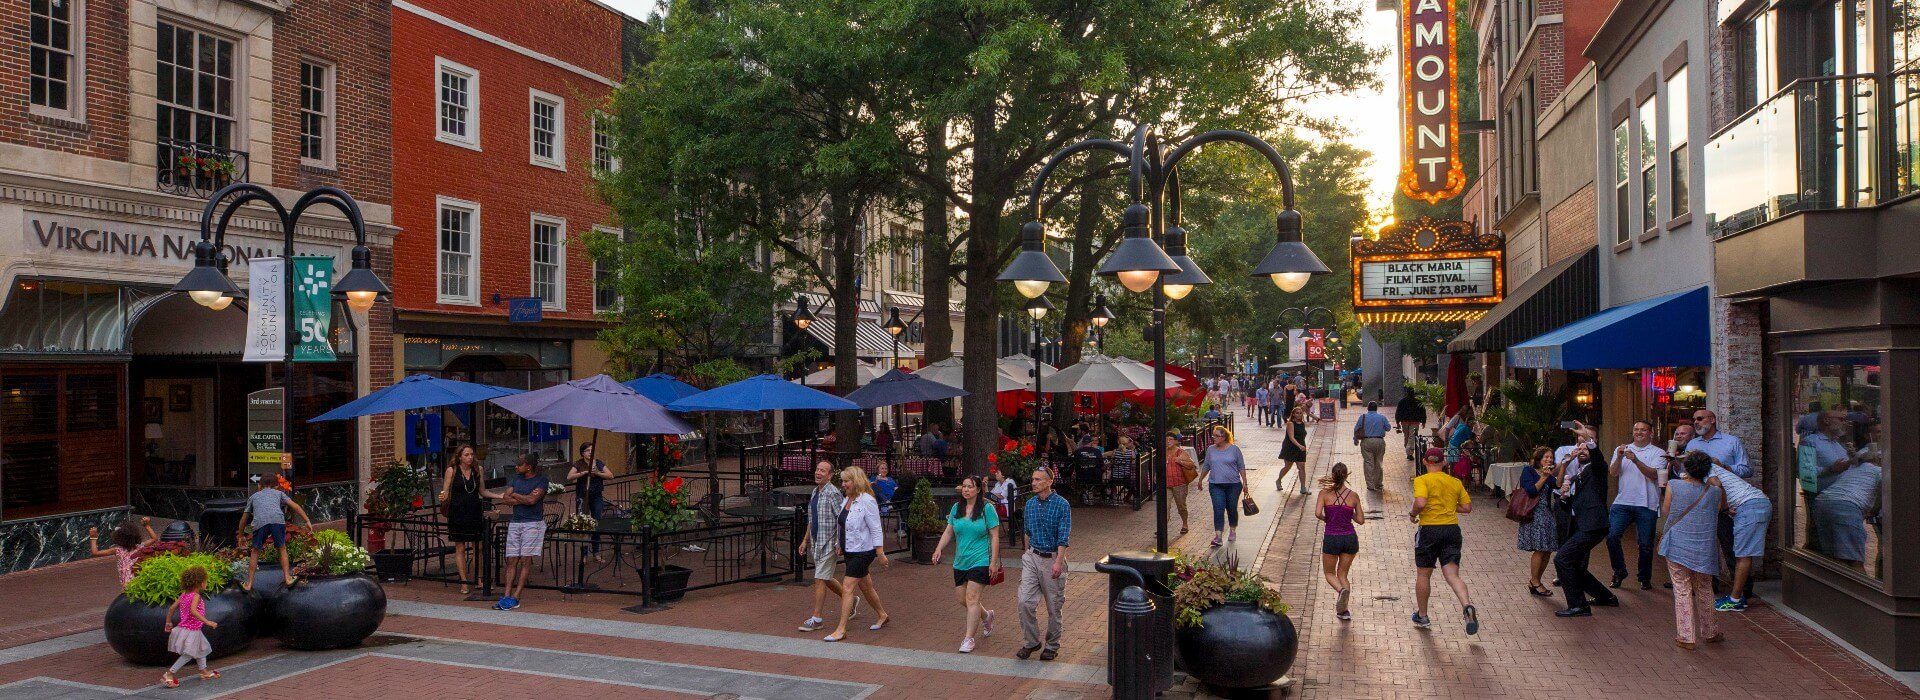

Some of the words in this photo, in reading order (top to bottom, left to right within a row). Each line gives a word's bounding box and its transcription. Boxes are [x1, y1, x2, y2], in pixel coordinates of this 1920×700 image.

[33, 219, 157, 258] VIRGINIA
[163, 234, 274, 267] NAONA
[1388, 264, 1424, 273] BLACK
[1427, 262, 1463, 272] MARIA
[1386, 275, 1411, 285] FILM
[1415, 273, 1465, 284] FESTIVAL
[1383, 287, 1404, 297] FRI.
[1409, 286, 1437, 296] JUNE
[269, 264, 278, 351] FOUNDATION
[260, 277, 270, 356] COMMUNITY
[301, 317, 327, 343] 50
[301, 345, 332, 354] YEARS
[1309, 346, 1322, 355] 50
